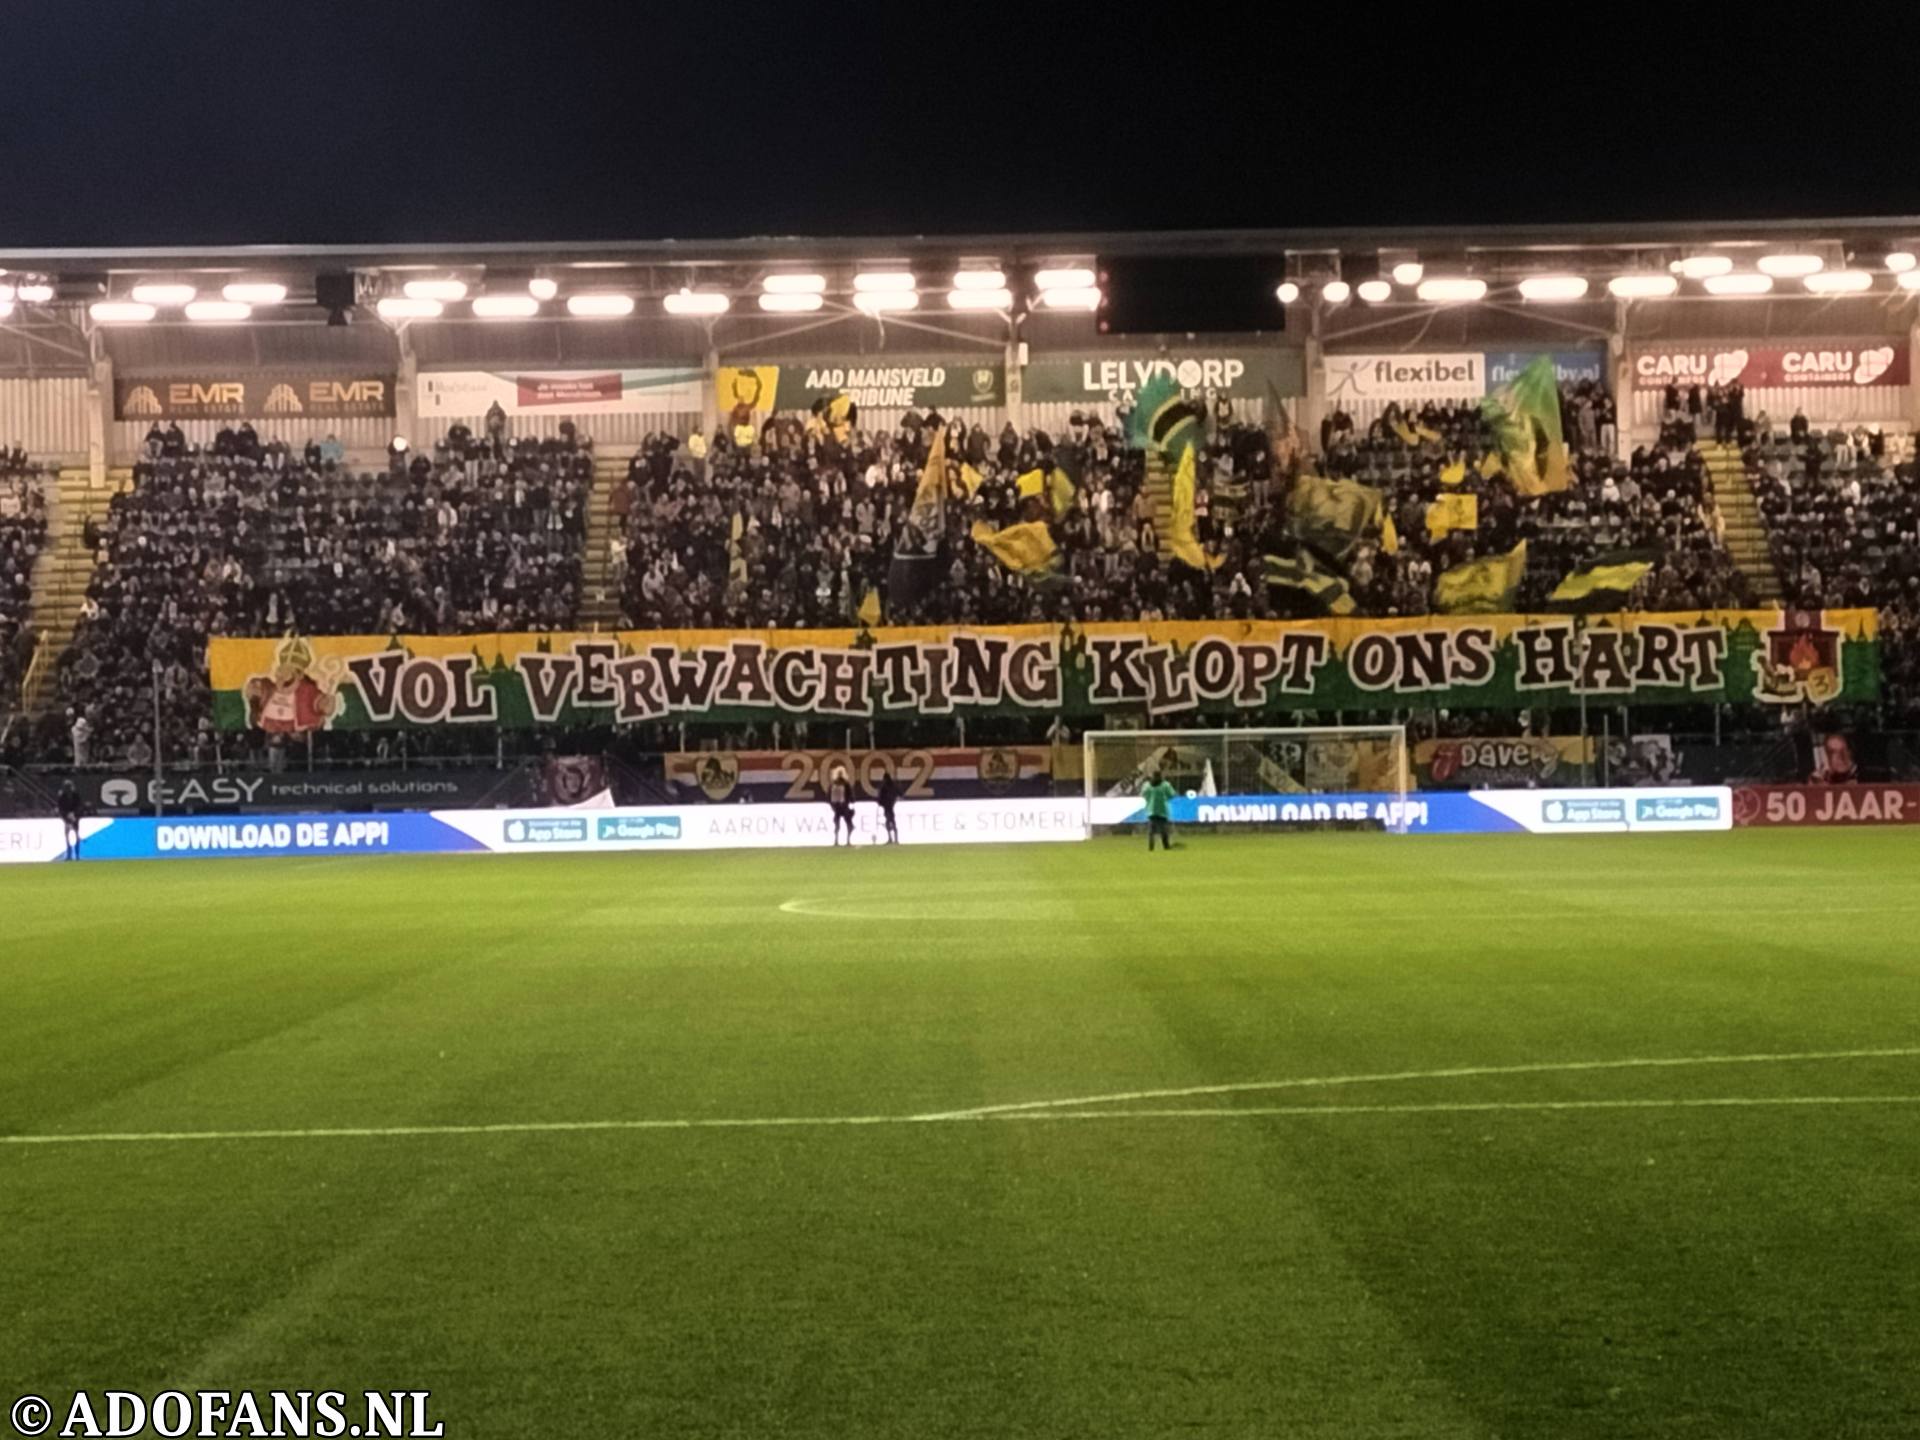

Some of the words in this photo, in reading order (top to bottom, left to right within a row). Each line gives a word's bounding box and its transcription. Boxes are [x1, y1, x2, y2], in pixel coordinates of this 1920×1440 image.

[1375, 360, 1475, 382] flexibel
[1637, 355, 1707, 375] CARU
[1782, 352, 1853, 372] CARU
[805, 369, 843, 388] AAD
[848, 367, 946, 387] MANSVELD
[1083, 359, 1245, 391] LELYDORP
[169, 382, 245, 403] EMR
[309, 381, 384, 402] EMR
[349, 650, 497, 724] VOL
[519, 631, 1060, 723] VERWACHTING
[1090, 634, 1330, 714] KLOPT
[1350, 628, 1493, 693] ONS
[1516, 623, 1727, 692] HART
[781, 750, 936, 799] 2002
[147, 777, 263, 804] EASY
[271, 783, 363, 796] technical
[368, 780, 459, 793] solutions
[1567, 809, 1590, 821] App
[1591, 808, 1621, 820] Store
[1655, 806, 1693, 819] Google
[1694, 804, 1718, 818] Play
[1766, 792, 1806, 821] 50
[708, 817, 786, 835] AARON
[954, 815, 966, 831] &
[977, 811, 1088, 829] STOMERIJ
[157, 824, 291, 850] DOWNLOAD
[297, 823, 327, 847] DE
[334, 821, 389, 846] APP!
